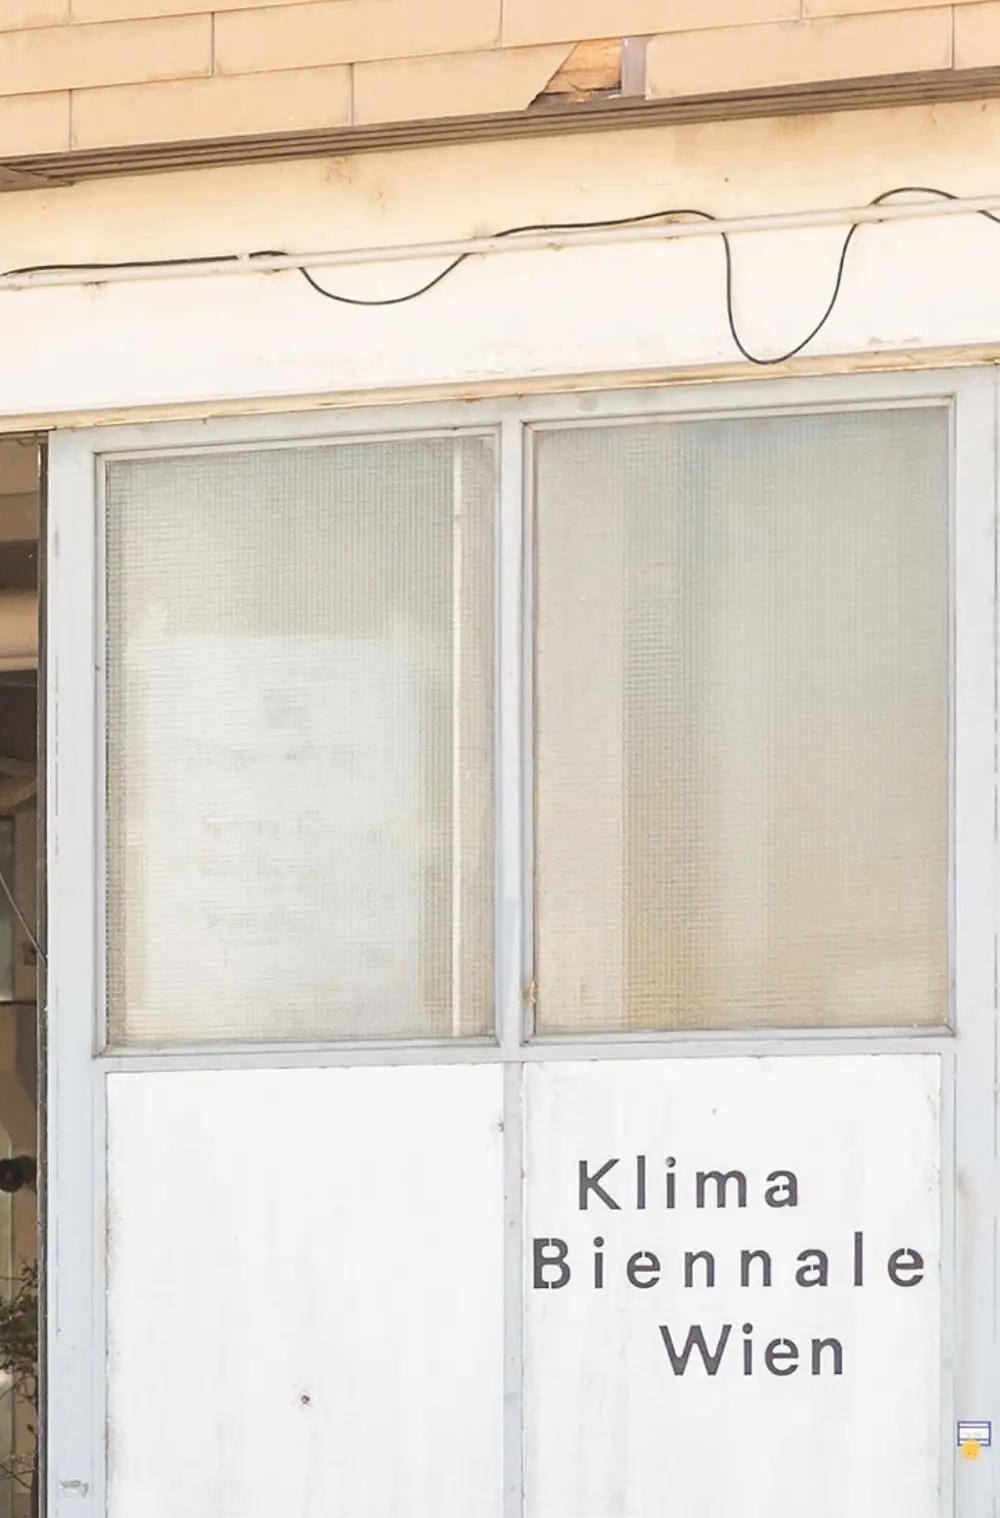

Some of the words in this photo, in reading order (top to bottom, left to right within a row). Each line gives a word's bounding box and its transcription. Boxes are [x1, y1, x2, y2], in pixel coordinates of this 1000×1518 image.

[578, 1155, 799, 1210] Klima
[532, 1231, 925, 1289] Biennale
[658, 1322, 844, 1376] Wien
